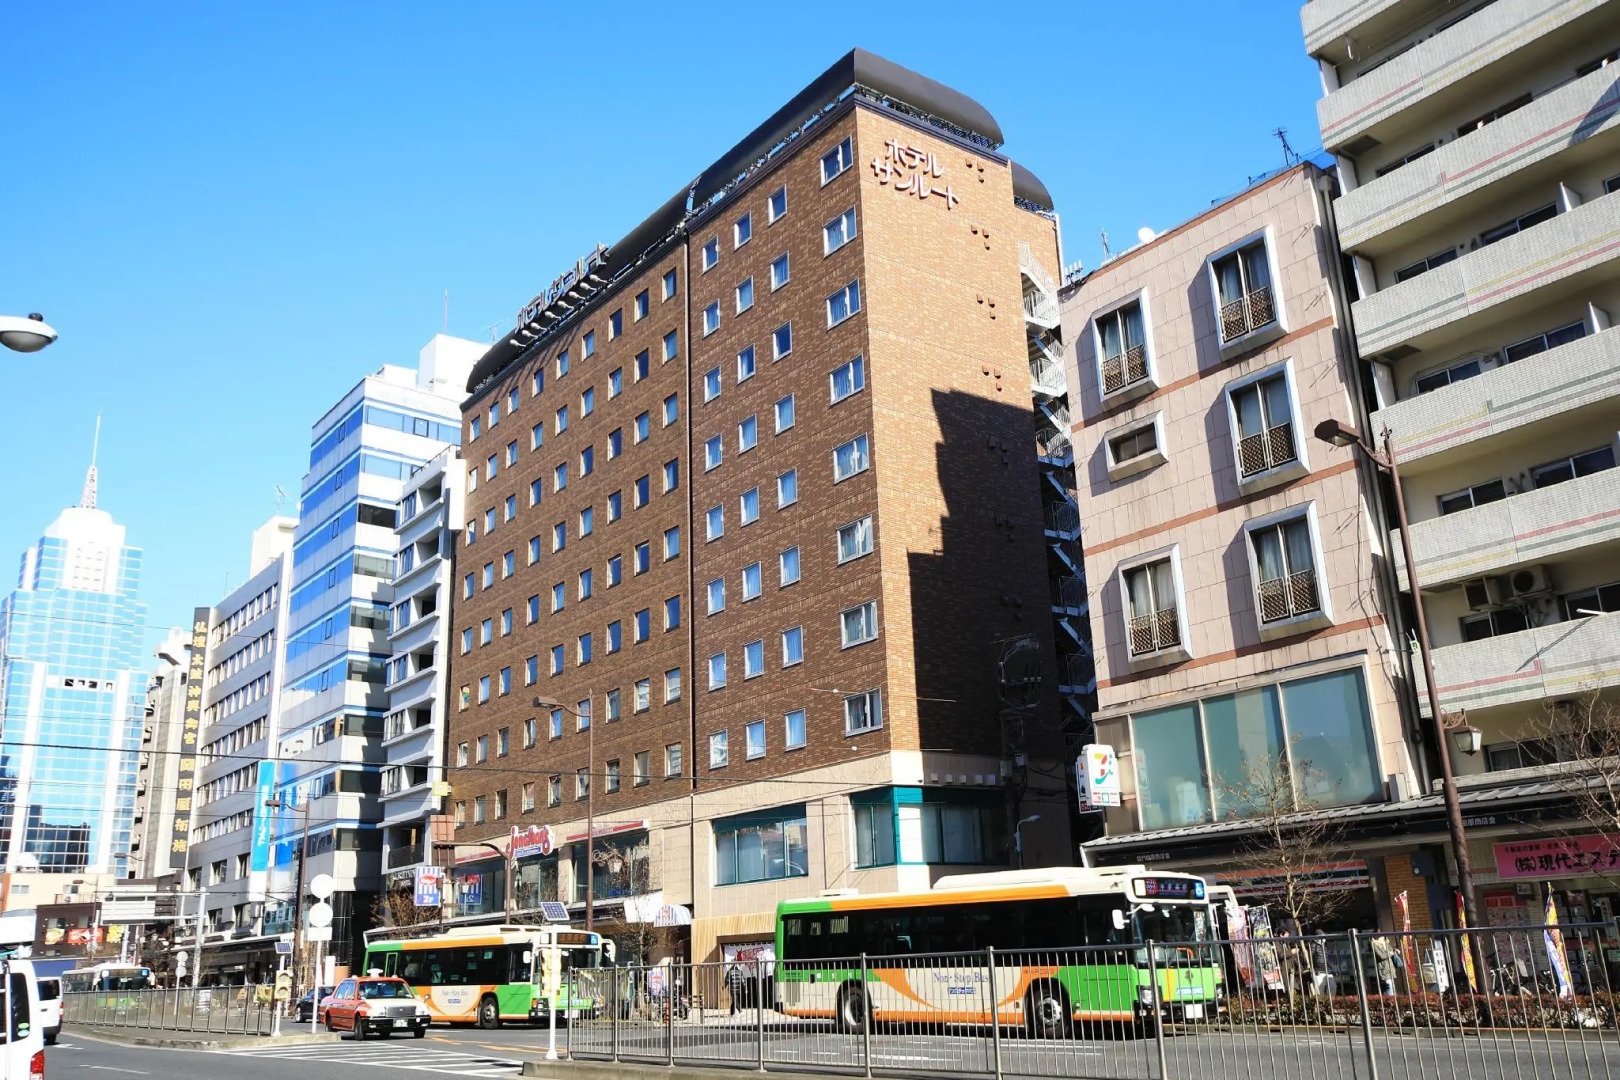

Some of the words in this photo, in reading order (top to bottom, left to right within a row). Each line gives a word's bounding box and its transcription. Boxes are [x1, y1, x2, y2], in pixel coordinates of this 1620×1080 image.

[884, 138, 944, 178] ホテル
[870, 158, 960, 211] サンルート
